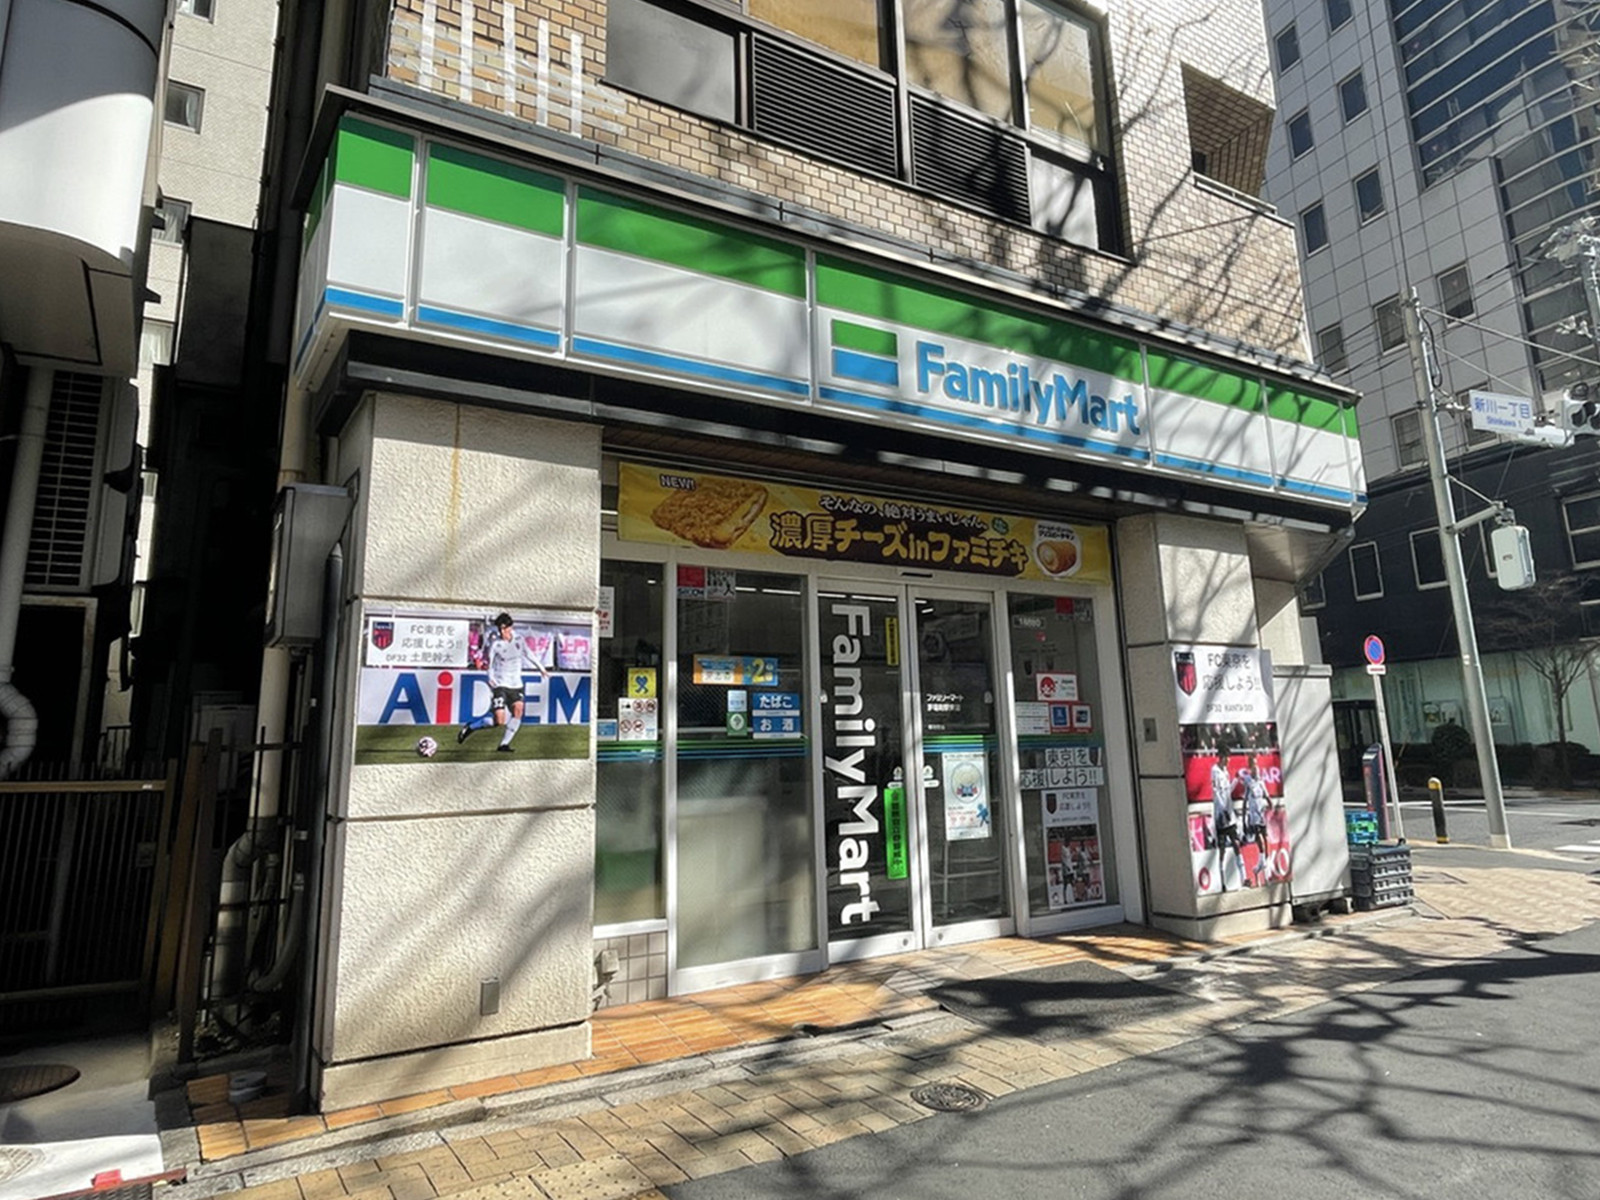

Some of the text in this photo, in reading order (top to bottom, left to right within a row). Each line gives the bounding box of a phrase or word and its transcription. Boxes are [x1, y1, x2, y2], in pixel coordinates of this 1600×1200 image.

[916, 340, 1140, 436] FamilyMart
[1474, 397, 1530, 418] 新川一丁目
[660, 474, 695, 490] NEW!
[771, 513, 1028, 570] 濃厚チーズinファミチキ
[410, 624, 455, 636] FC東京を
[378, 671, 591, 725] AiDEM
[759, 694, 793, 709] たばこ
[824, 603, 881, 925] FamilyMart
